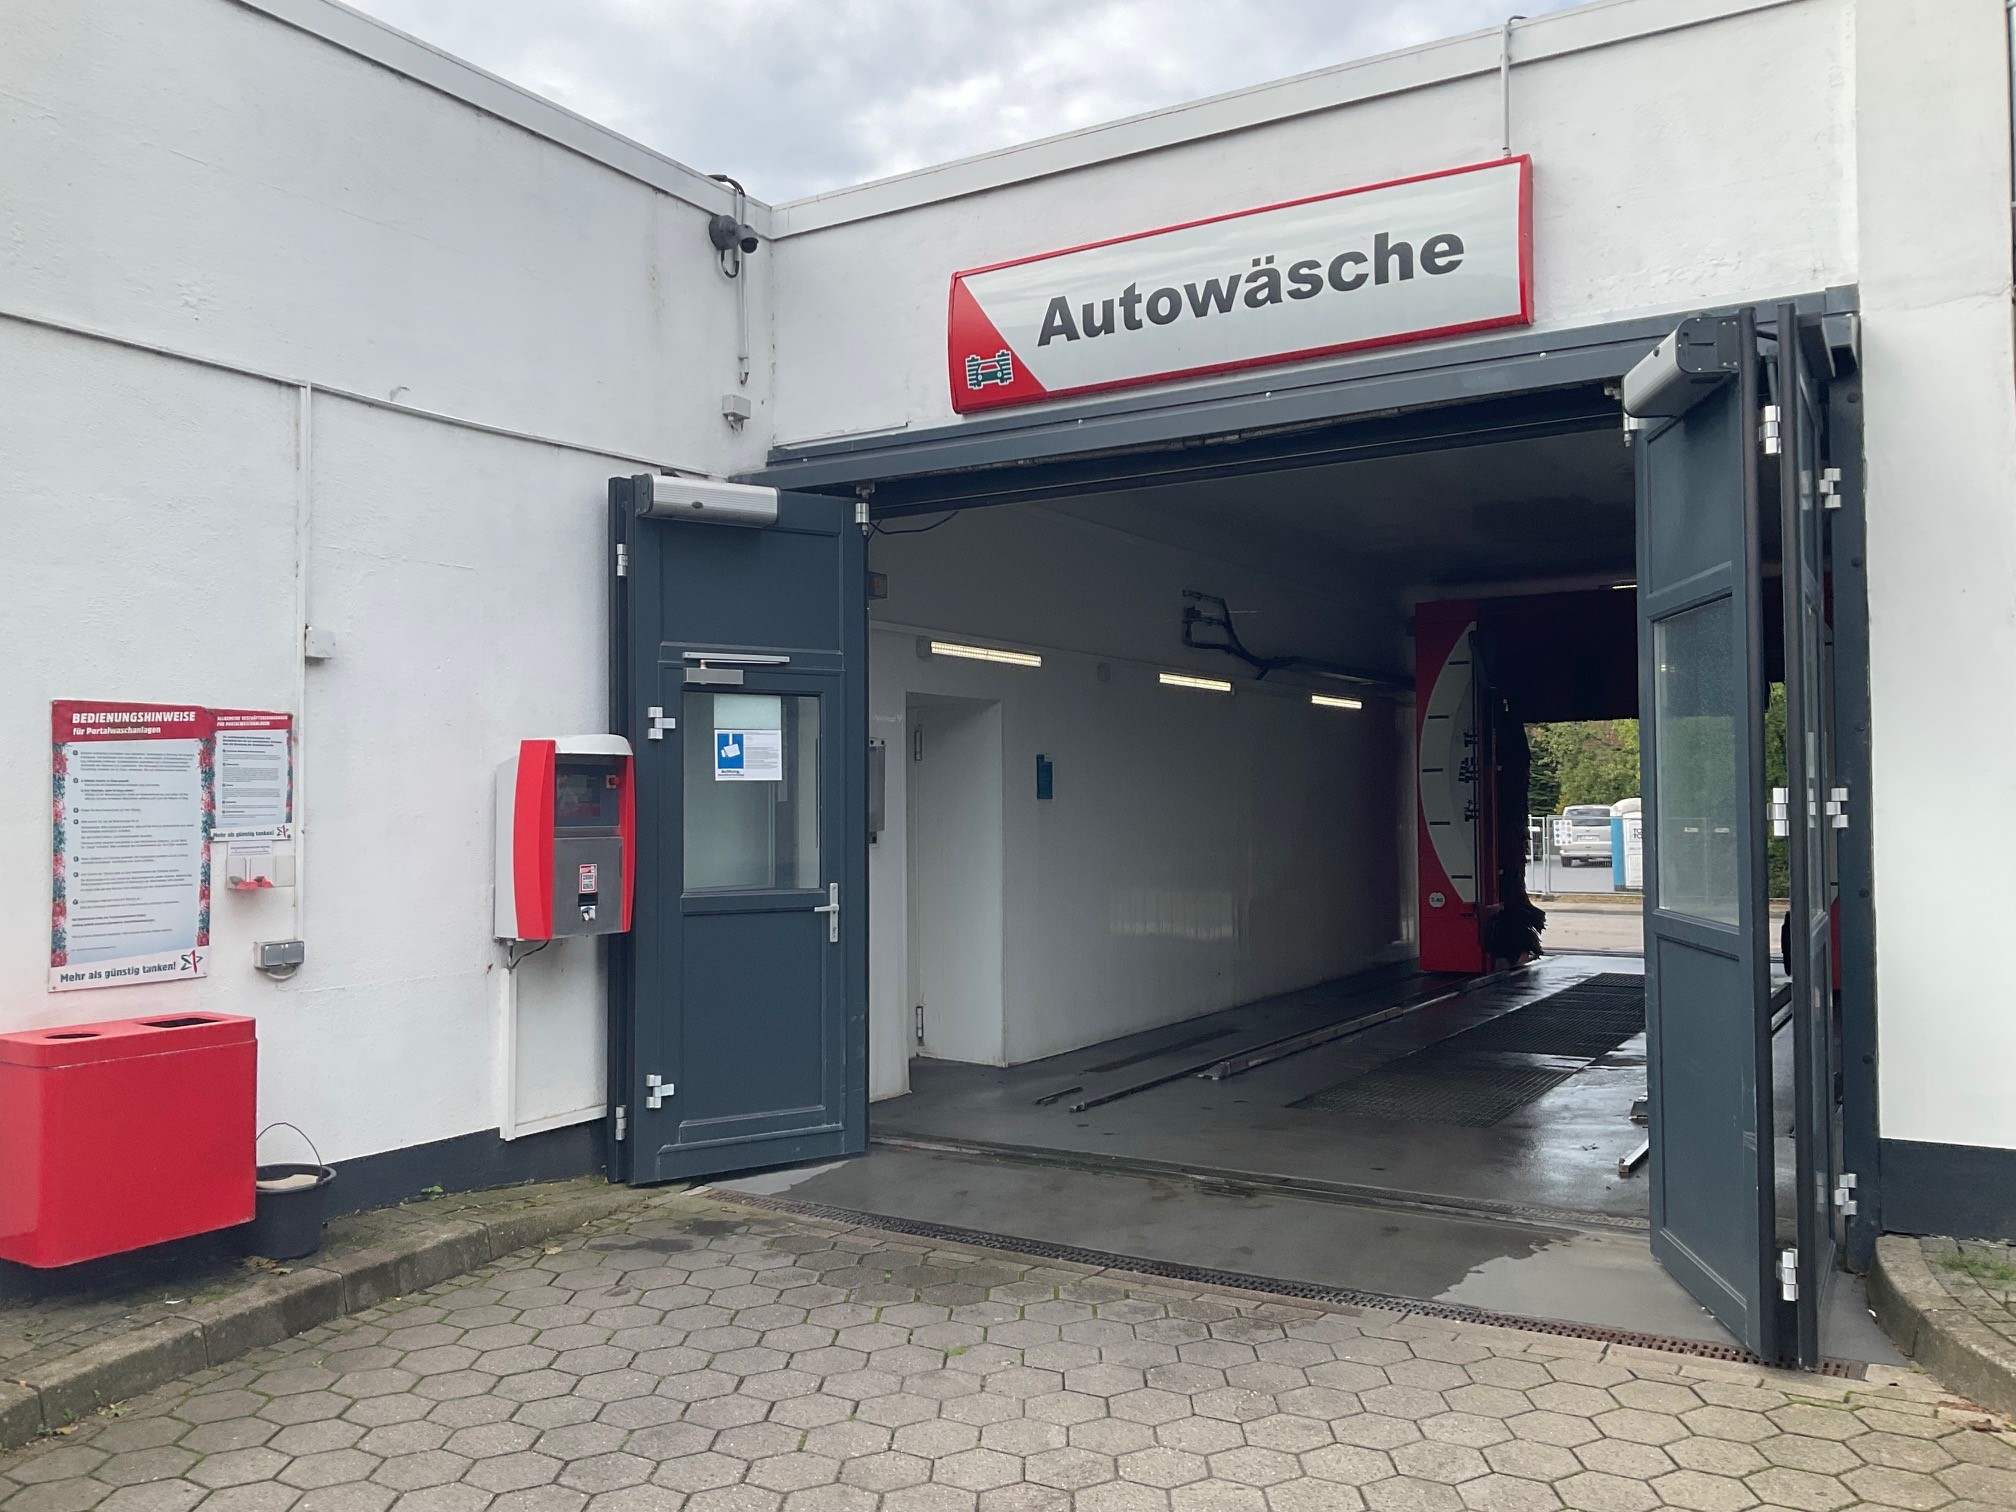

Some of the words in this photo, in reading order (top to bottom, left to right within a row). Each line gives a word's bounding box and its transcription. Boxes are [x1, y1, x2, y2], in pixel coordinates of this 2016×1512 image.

[1037, 231, 1465, 347] Autowäsche
[72, 711, 196, 724] BEDIENUNGSHINWEISE
[72, 727, 85, 736] für
[86, 726, 162, 736] Portalwaschanlagen
[236, 830, 254, 839] günstig
[60, 971, 86, 983] Mehr
[88, 969, 102, 980] als
[104, 965, 141, 980] günstig
[142, 961, 177, 974] tanken!
